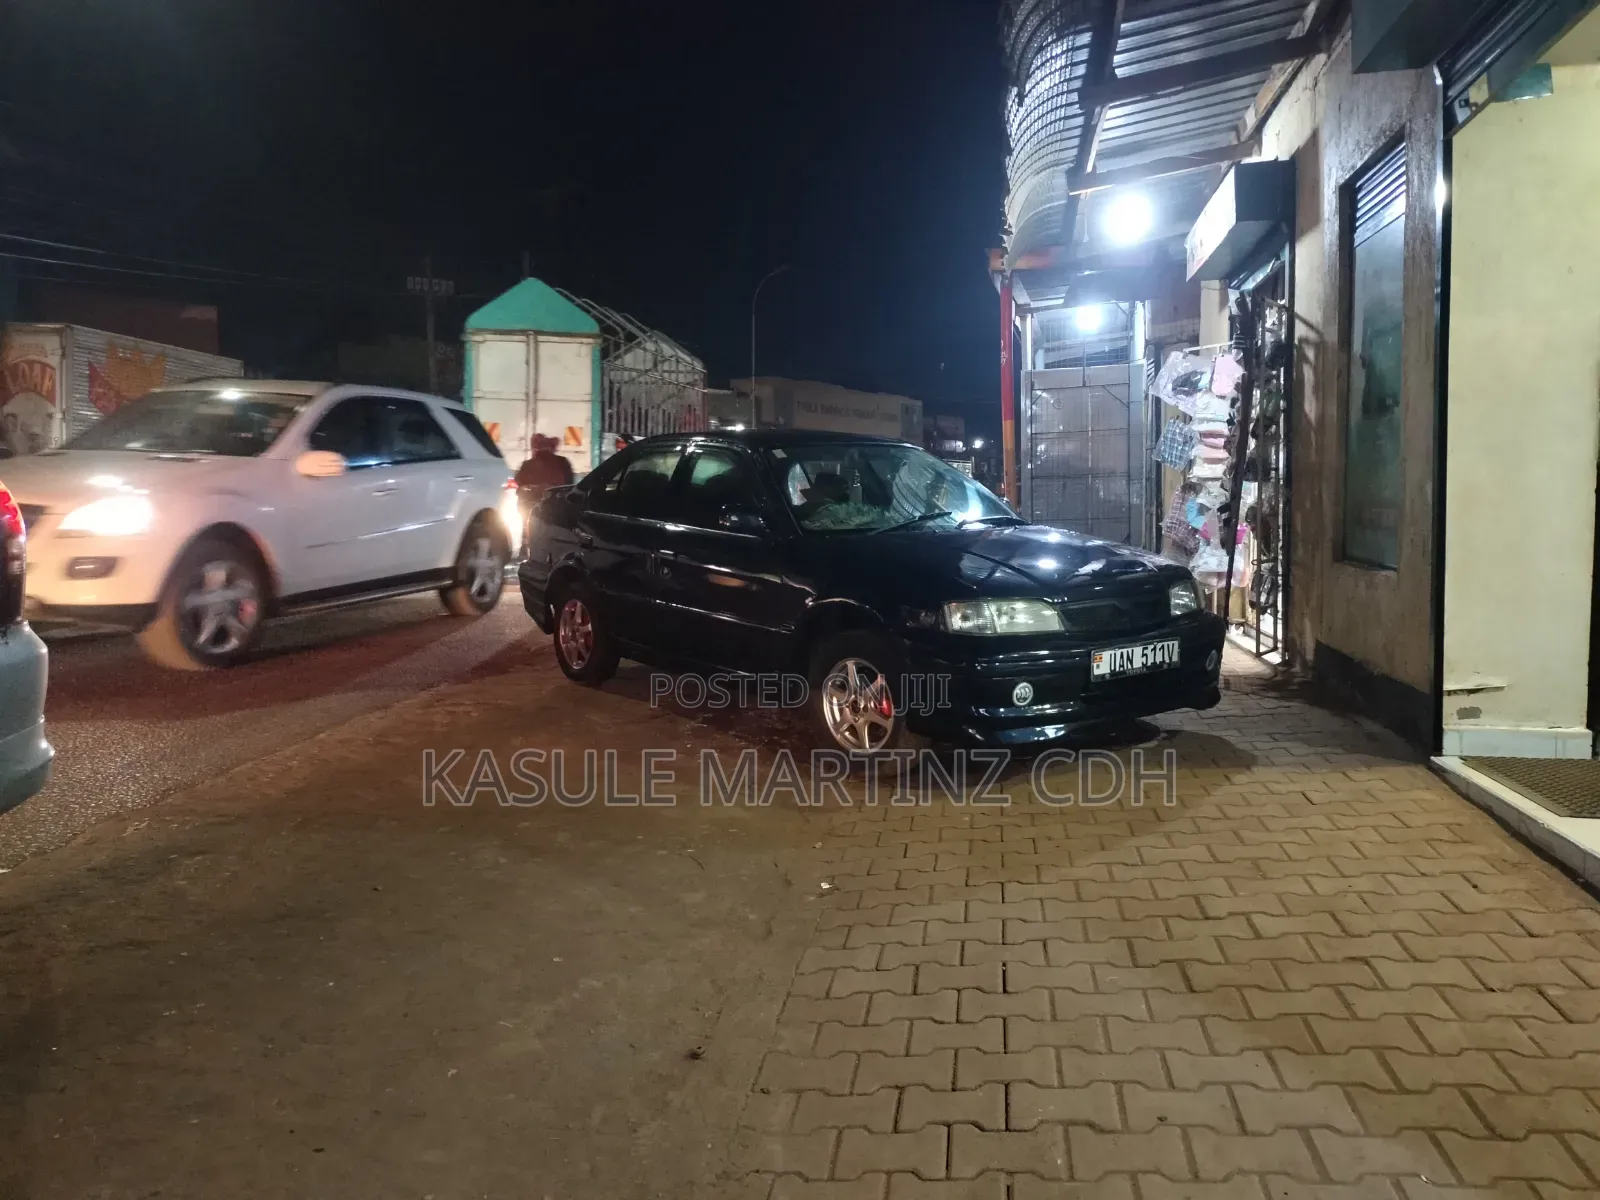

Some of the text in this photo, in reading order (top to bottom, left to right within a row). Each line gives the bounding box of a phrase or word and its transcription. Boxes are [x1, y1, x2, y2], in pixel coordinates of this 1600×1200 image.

[1110, 643, 1175, 672] UAN 511V
[1126, 667, 1147, 675] TOYOTA
